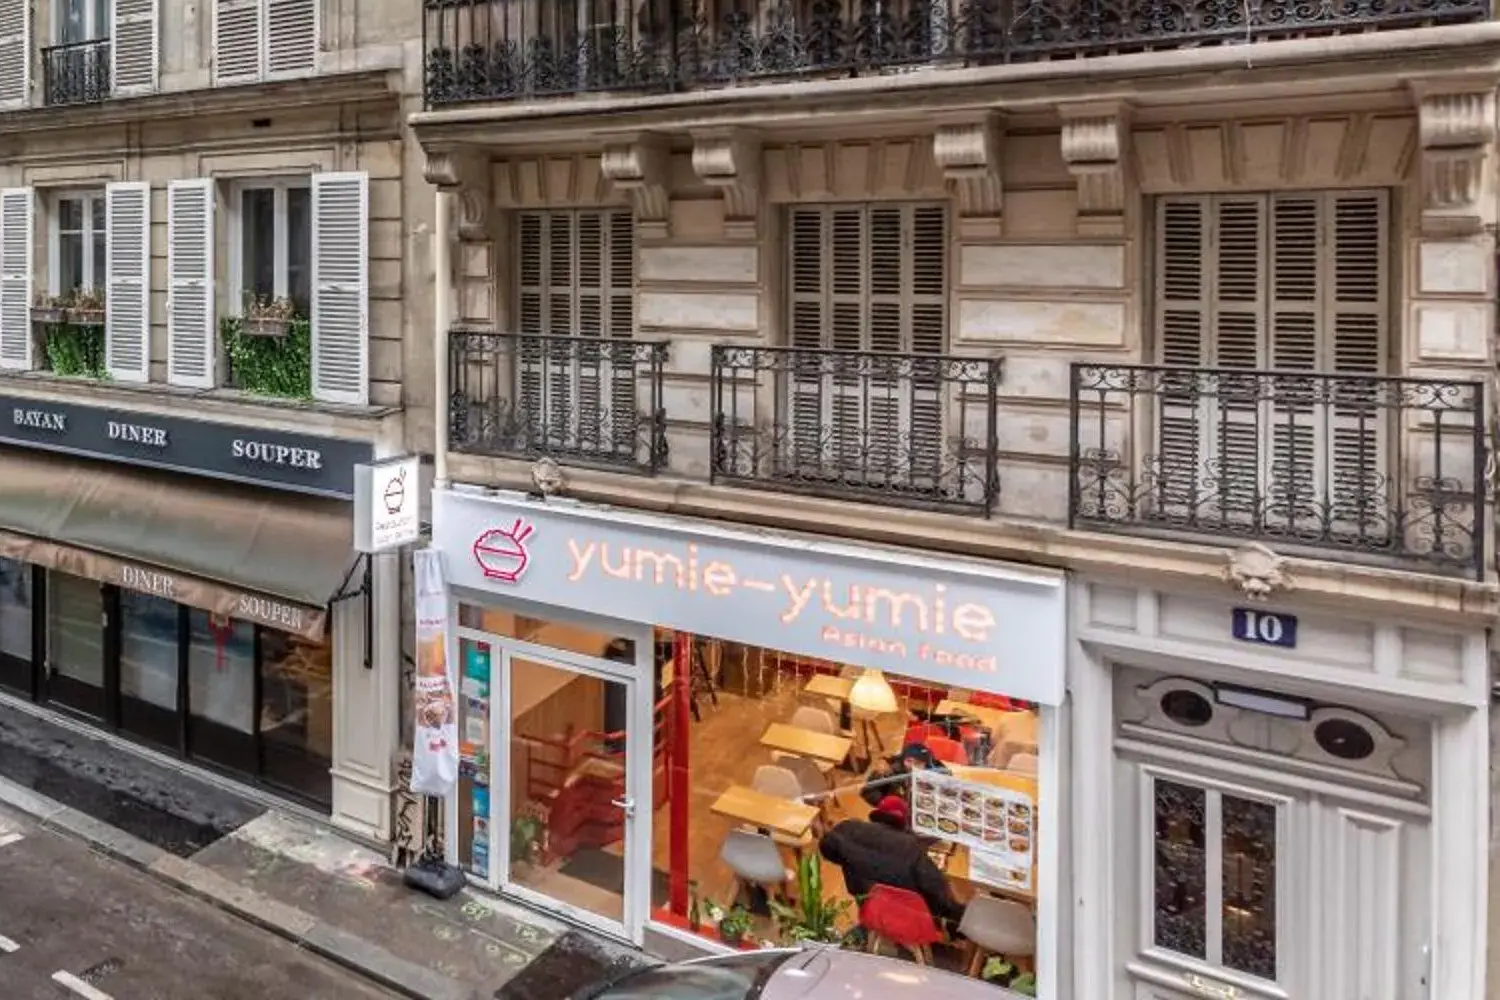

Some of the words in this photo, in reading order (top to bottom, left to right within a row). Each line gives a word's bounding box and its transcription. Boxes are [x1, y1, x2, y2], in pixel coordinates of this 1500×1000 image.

[13, 408, 66, 431] BAYAN
[108, 421, 168, 446] DINER
[232, 439, 323, 470] SOUPER
[122, 565, 174, 595] DINER
[566, 537, 997, 643] yumie-yumie
[821, 624, 907, 658] Asian
[1244, 611, 1283, 641] 10
